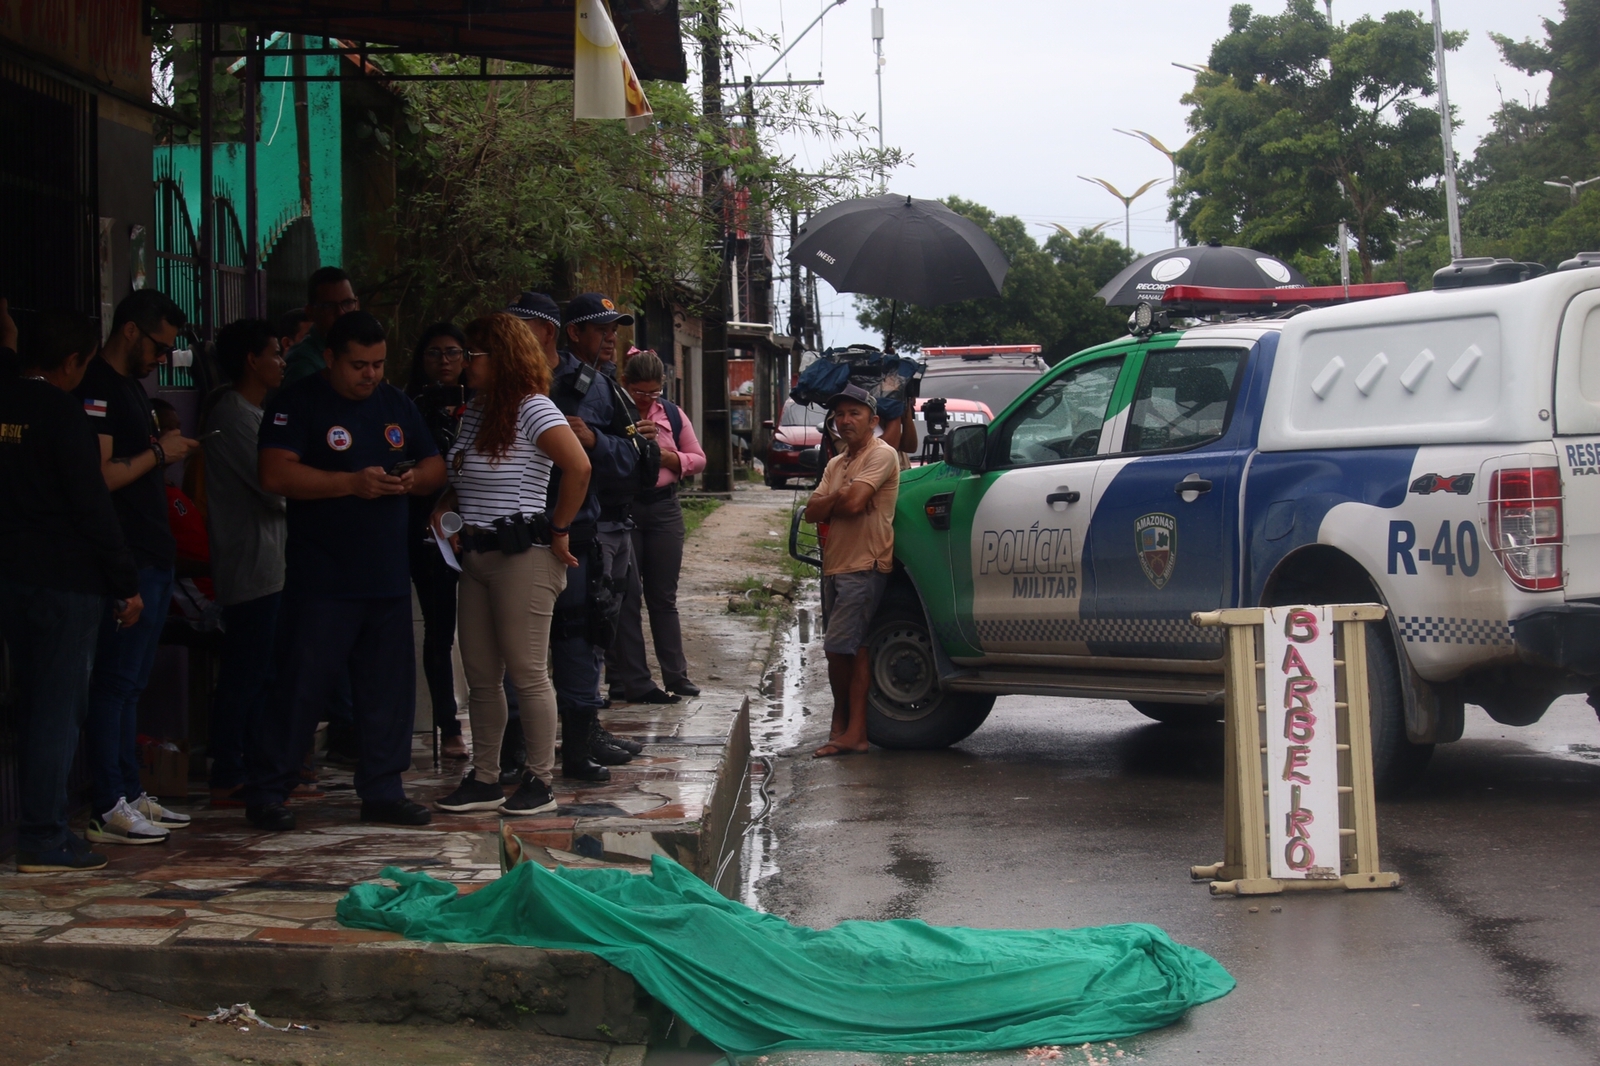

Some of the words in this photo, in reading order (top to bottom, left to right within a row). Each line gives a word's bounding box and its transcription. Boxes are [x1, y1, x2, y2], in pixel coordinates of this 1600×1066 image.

[816, 250, 836, 265] INESIS
[1136, 515, 1174, 532] AMAZONAS
[980, 520, 1075, 575] POLÍCIA
[1387, 520, 1480, 577] R-40
[1163, 551, 1175, 579] Militar
[1012, 577, 1077, 598] MILITAR
[1281, 607, 1320, 871] BARBEIRO
